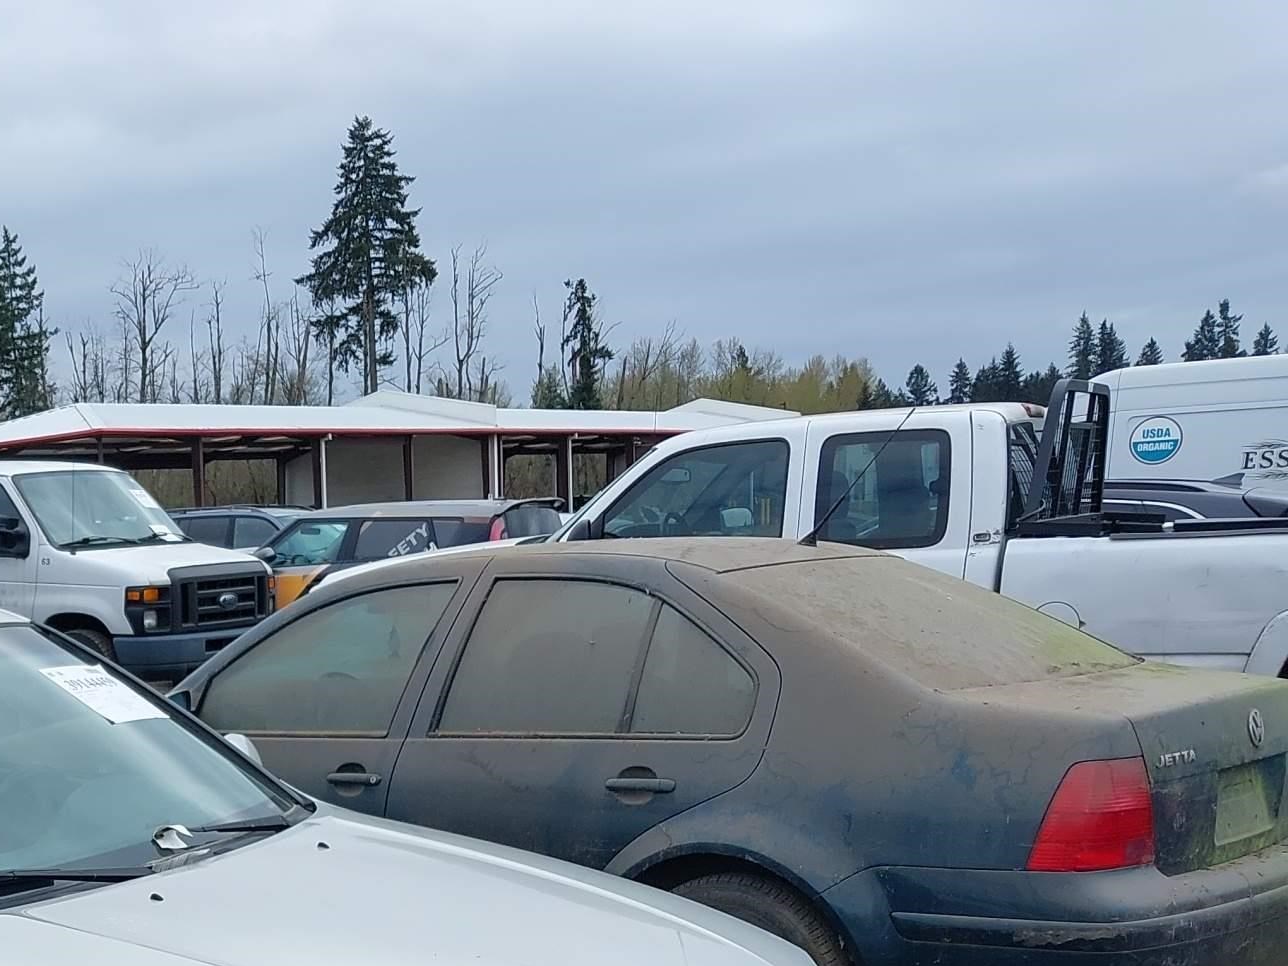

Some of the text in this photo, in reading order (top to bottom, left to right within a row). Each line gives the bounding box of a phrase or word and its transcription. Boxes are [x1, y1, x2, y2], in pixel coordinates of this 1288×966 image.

[1142, 427, 1171, 439] USDA
[1137, 441, 1174, 452] ORGANIC
[1156, 749, 1197, 768] JETTA
